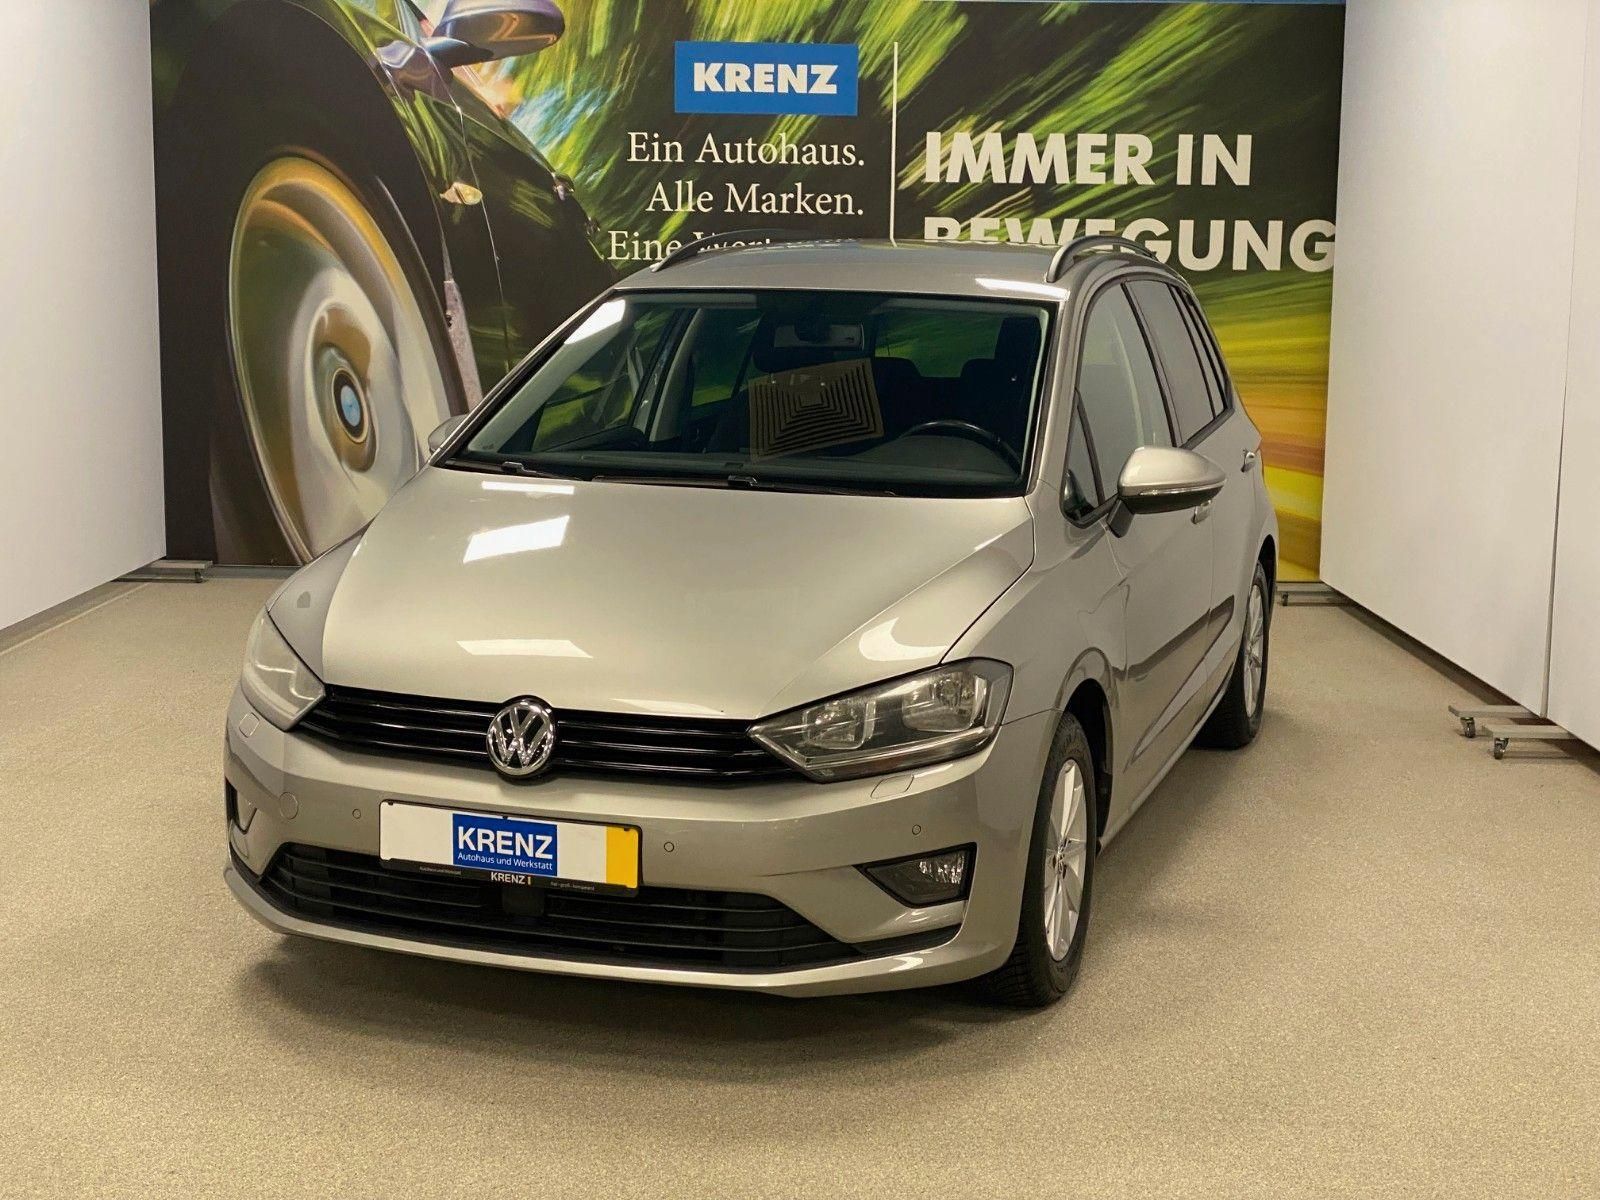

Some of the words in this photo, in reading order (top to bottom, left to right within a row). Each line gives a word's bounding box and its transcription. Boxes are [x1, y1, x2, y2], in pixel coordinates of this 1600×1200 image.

[693, 62, 839, 95] KRENZ
[626, 131, 685, 163] Ein
[694, 132, 865, 166] Autohaus.
[924, 131, 1156, 186] IMMER
[1176, 133, 1253, 186] IN
[645, 179, 714, 213] Alle
[723, 182, 864, 216] Marken.
[607, 230, 682, 261] Eine
[458, 826, 553, 860] KRENZ
[457, 852, 495, 864] Autohaus
[496, 857, 512, 866] und
[513, 859, 553, 871] Werkstatt
[490, 871, 526, 885] KRENZ
